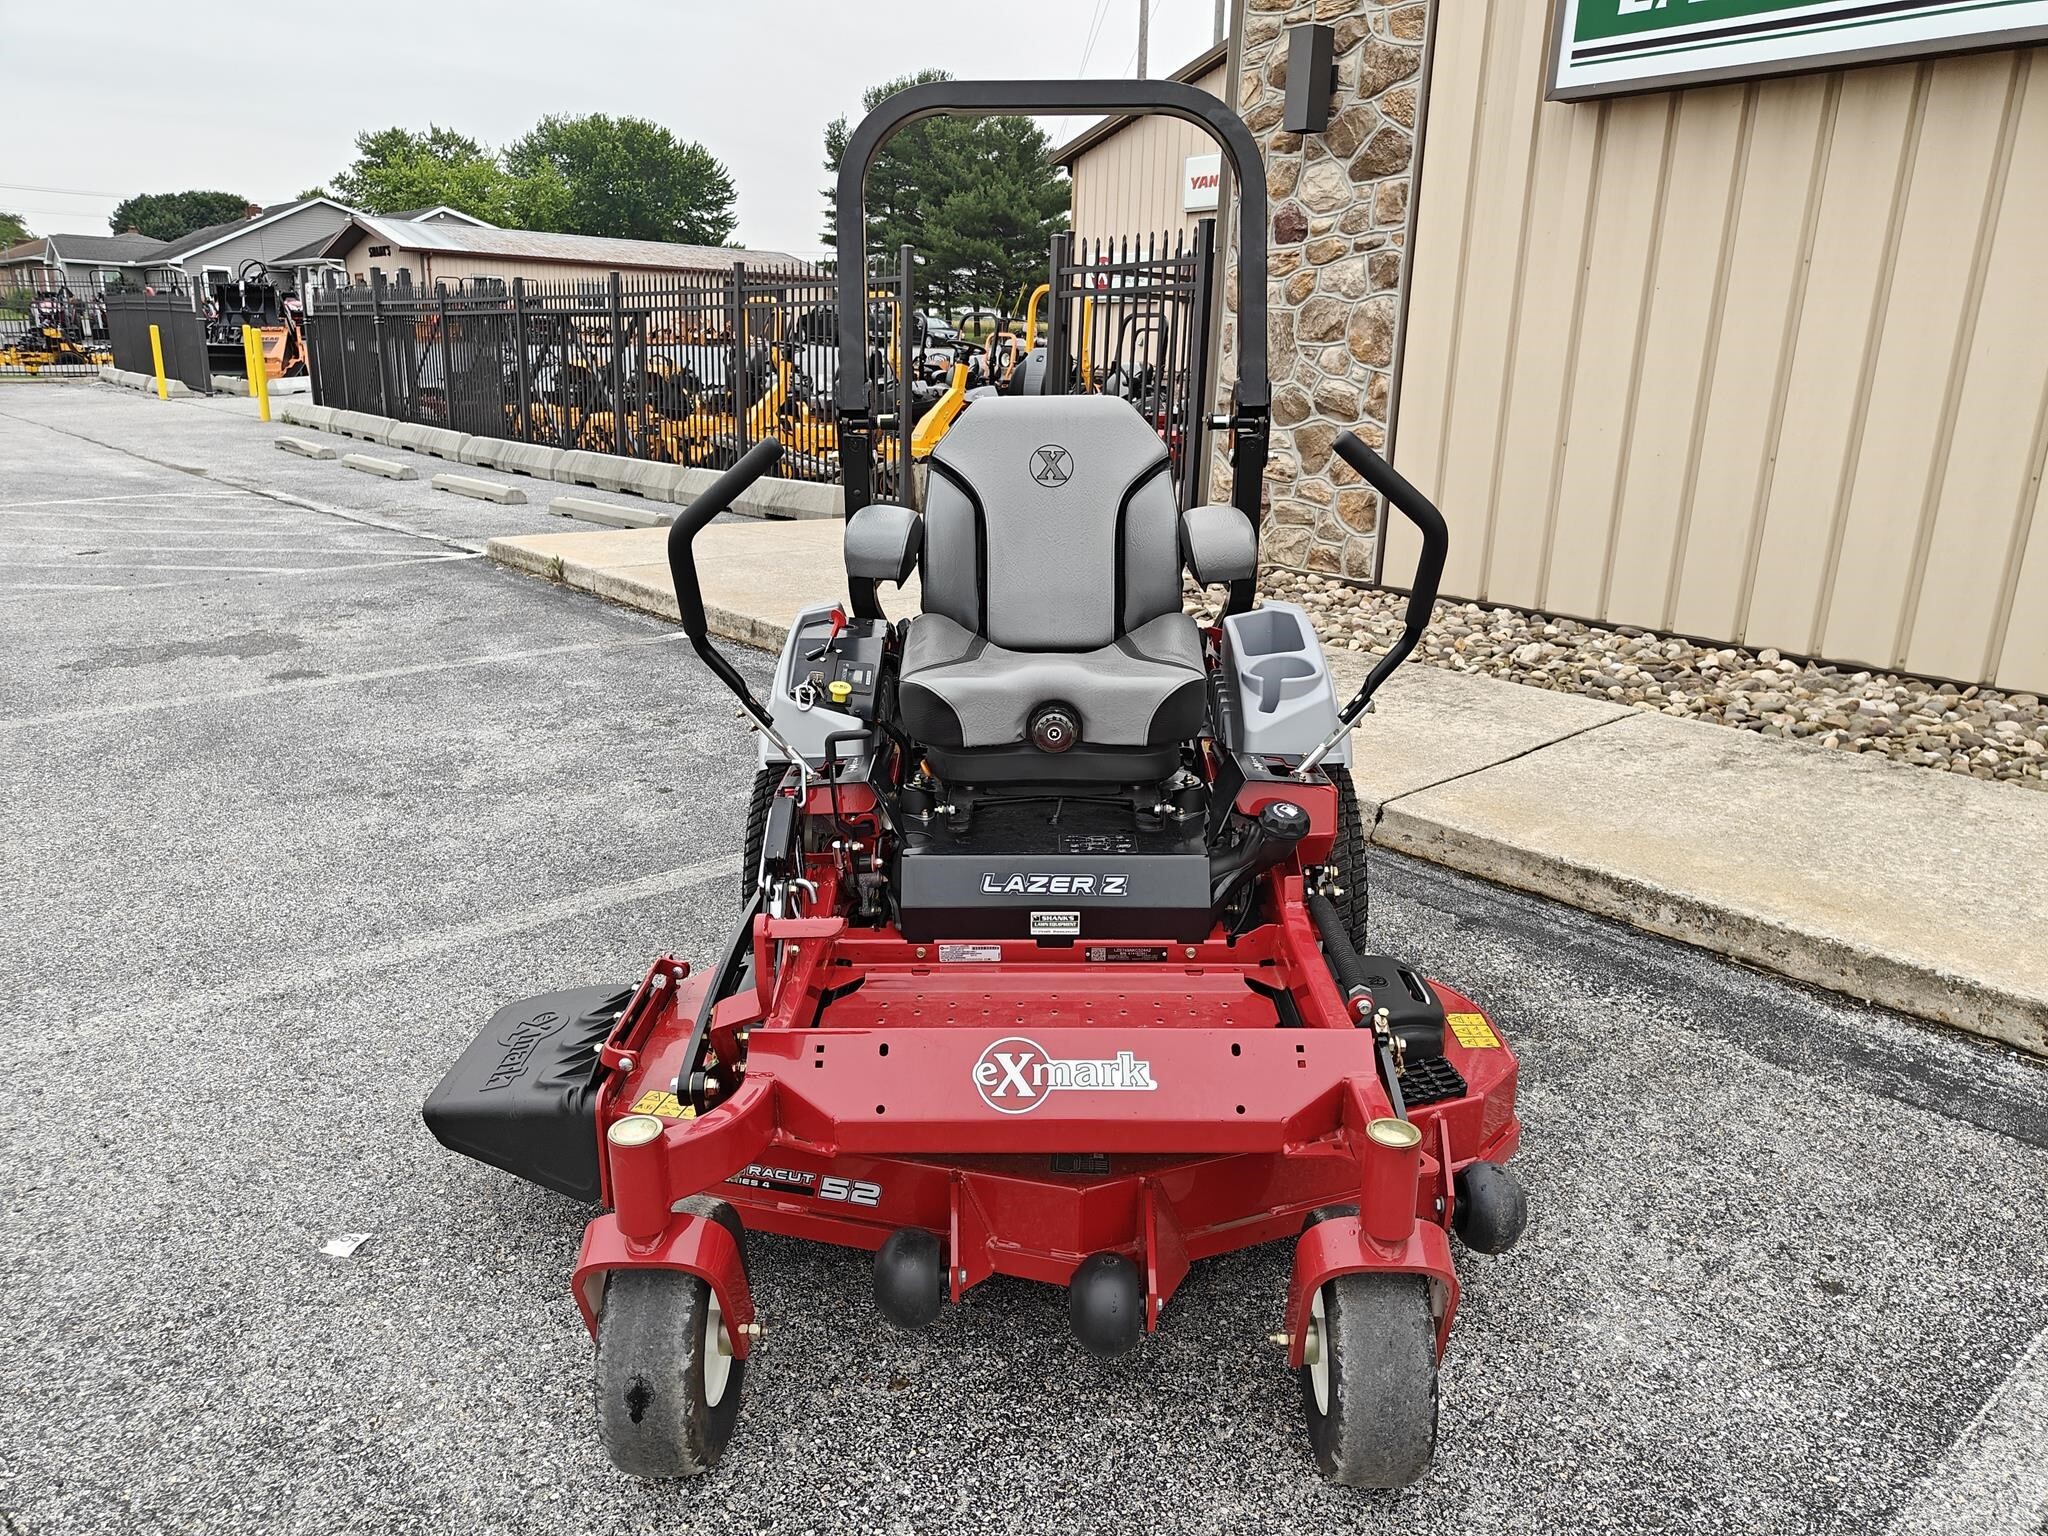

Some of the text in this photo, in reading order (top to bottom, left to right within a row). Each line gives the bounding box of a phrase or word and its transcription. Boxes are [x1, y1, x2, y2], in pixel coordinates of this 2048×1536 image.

[981, 874, 1127, 895] LAZER Z
[744, 1164, 816, 1184] RACUT
[818, 1176, 882, 1207] 52
